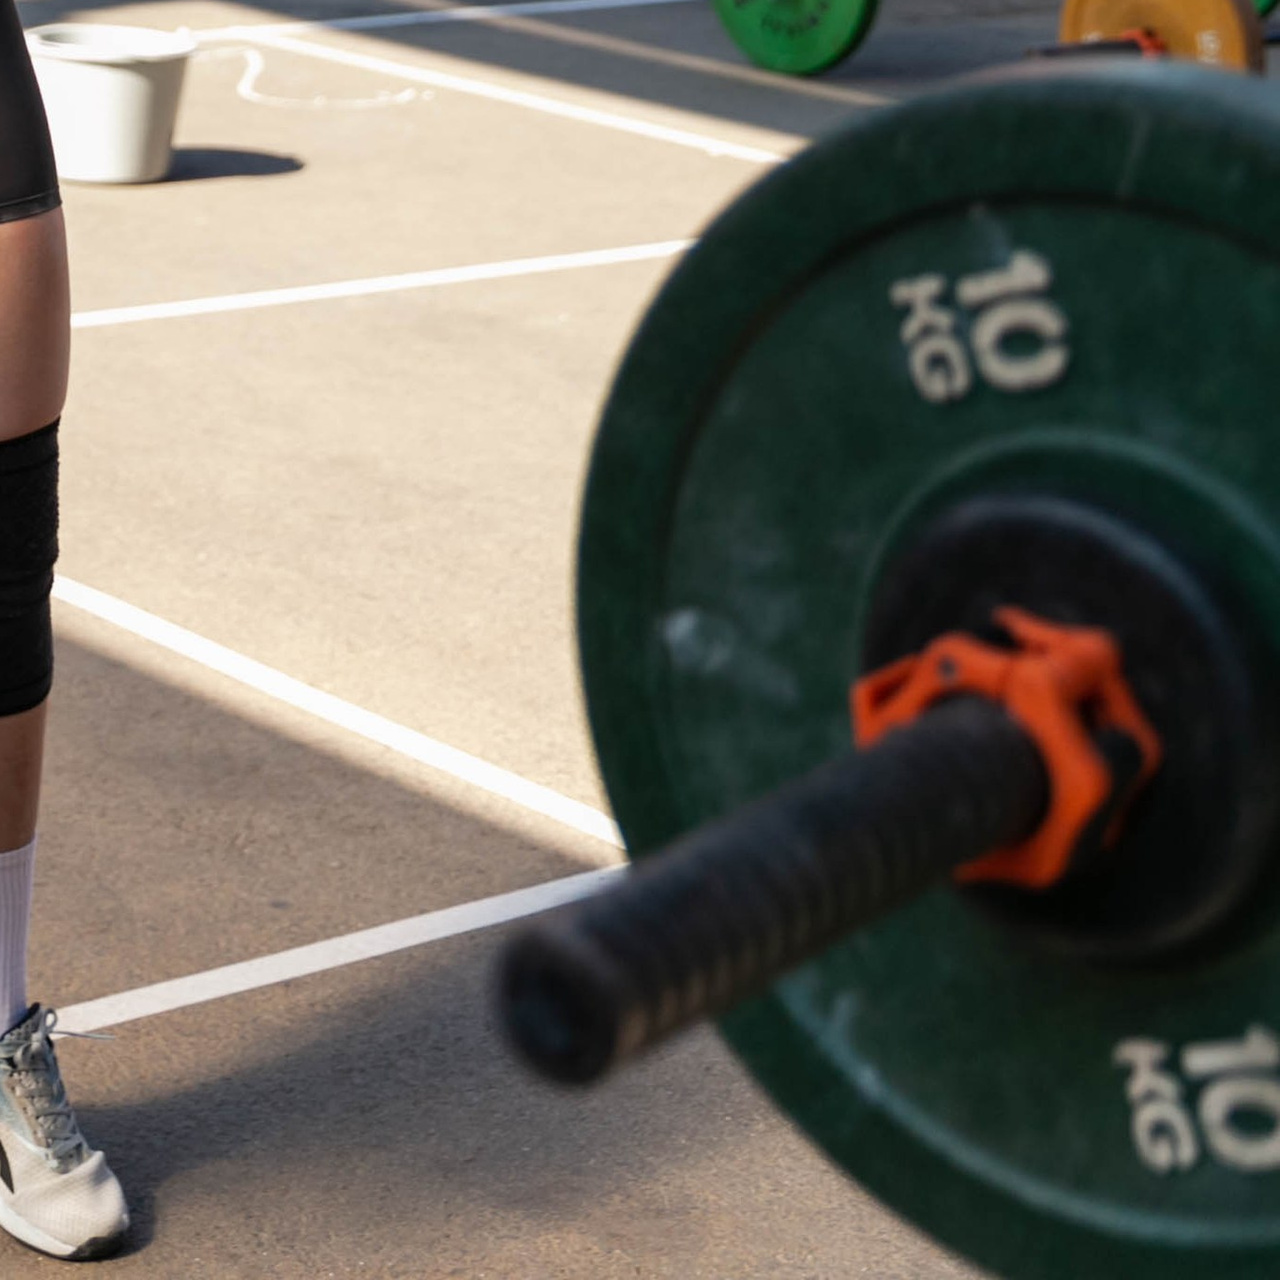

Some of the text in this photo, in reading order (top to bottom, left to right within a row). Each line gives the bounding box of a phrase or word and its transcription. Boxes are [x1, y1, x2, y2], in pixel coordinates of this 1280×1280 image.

[890, 271, 970, 404] KG
[956, 250, 1070, 390] 10
[1112, 1037, 1197, 1174] KG
[1181, 1023, 1280, 1170] 10
